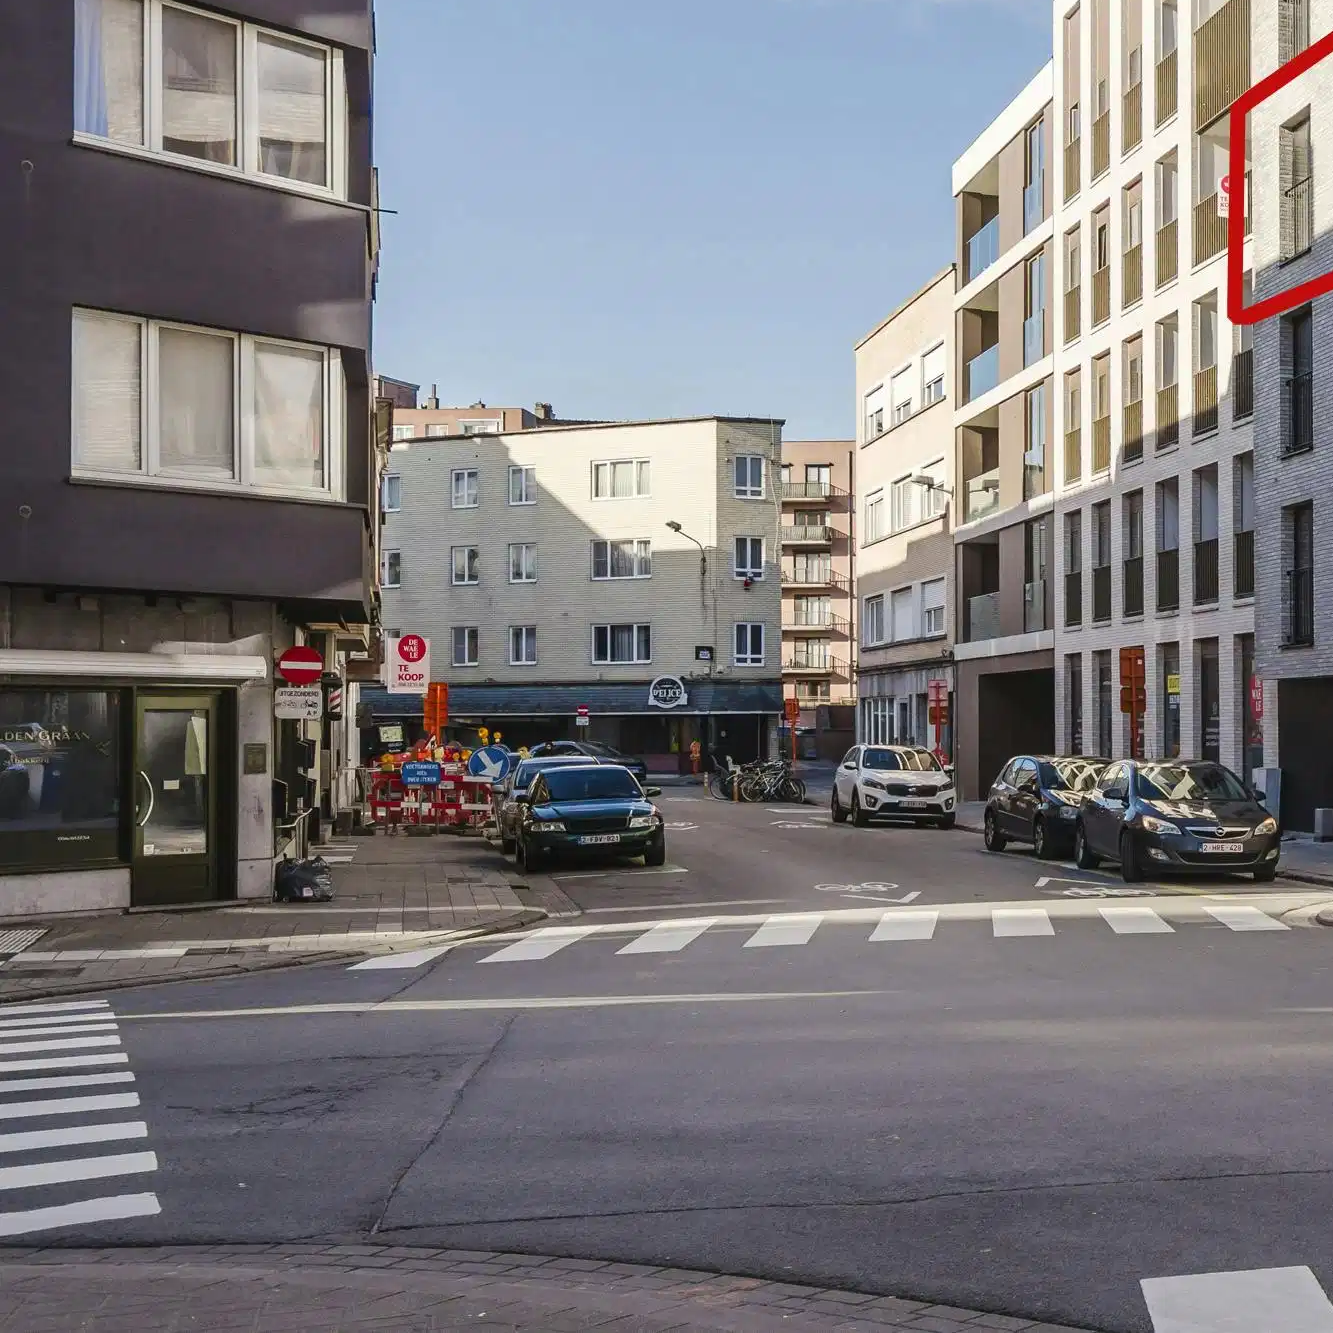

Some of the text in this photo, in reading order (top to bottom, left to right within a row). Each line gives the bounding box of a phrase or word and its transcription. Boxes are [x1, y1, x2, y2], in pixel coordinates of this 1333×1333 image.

[409, 651, 419, 659] LE
[398, 664, 409, 672] TE
[398, 673, 424, 681] KOOP
